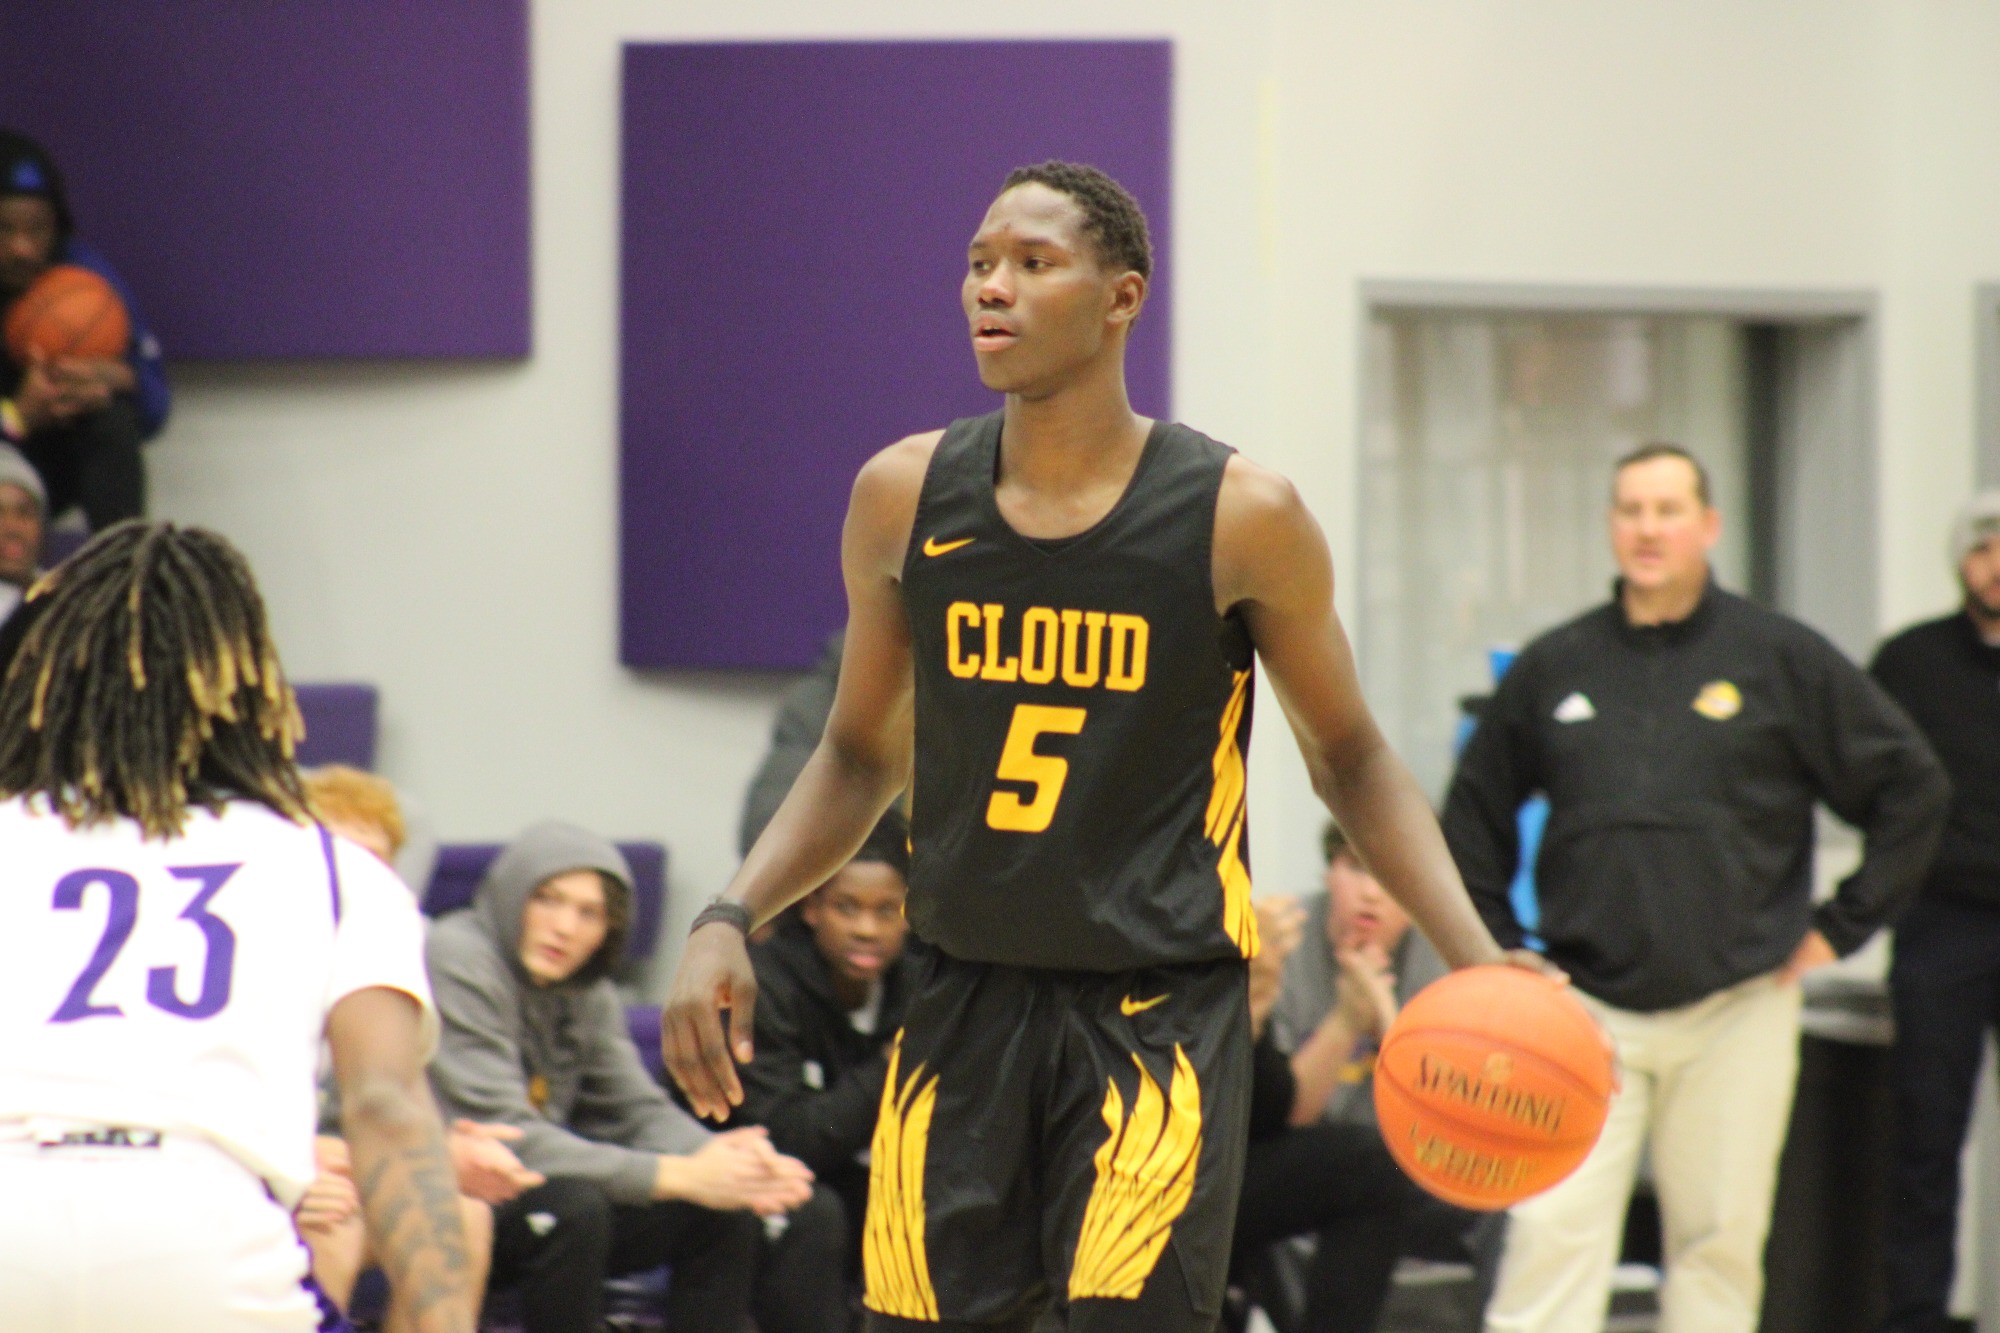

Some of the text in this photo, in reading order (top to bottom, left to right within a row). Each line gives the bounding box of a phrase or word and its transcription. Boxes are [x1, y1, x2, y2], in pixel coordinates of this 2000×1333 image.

[946, 601, 1149, 692] CLOUD
[986, 703, 1087, 833] 5
[47, 862, 245, 1023] 23
[1414, 1053, 1567, 1135] SPALDING
